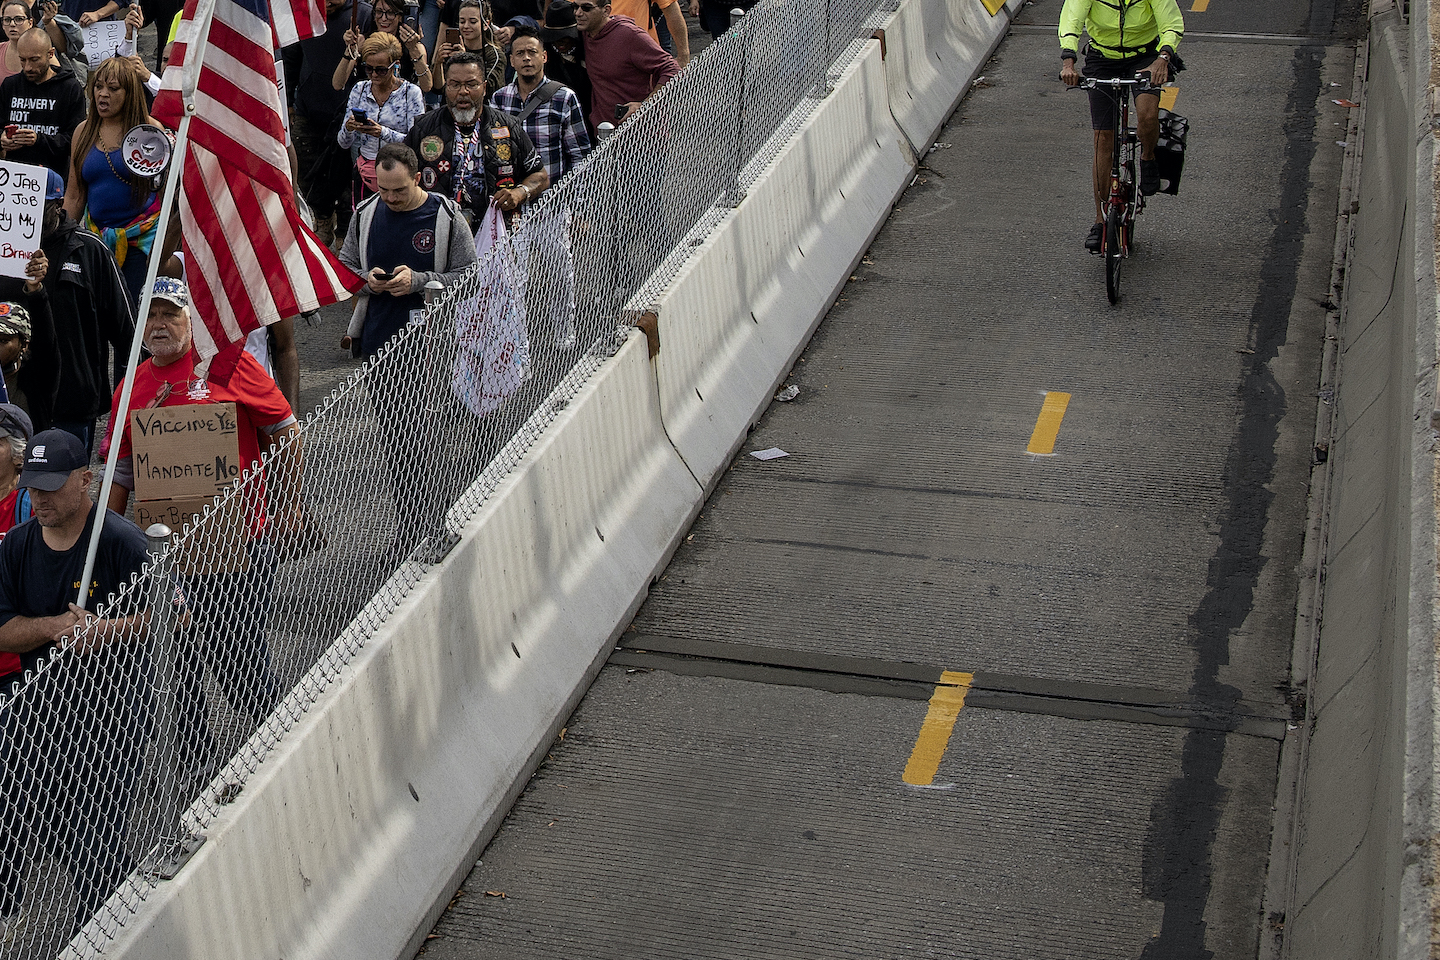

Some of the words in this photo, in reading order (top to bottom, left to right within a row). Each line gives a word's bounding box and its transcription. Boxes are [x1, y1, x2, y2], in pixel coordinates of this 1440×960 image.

[84, 26, 99, 50] door
[11, 96, 56, 111] BRAVERY
[10, 110, 30, 123] NOT
[126, 157, 161, 173] SUCKS
[13, 173, 41, 192] JAB
[11, 193, 39, 207] JOB
[18, 212, 36, 239] My
[135, 412, 217, 437] VACCINE
[215, 411, 236, 432] YES
[136, 452, 214, 479] MANDATE
[215, 455, 239, 481] NO
[137, 508, 166, 525] PUT
